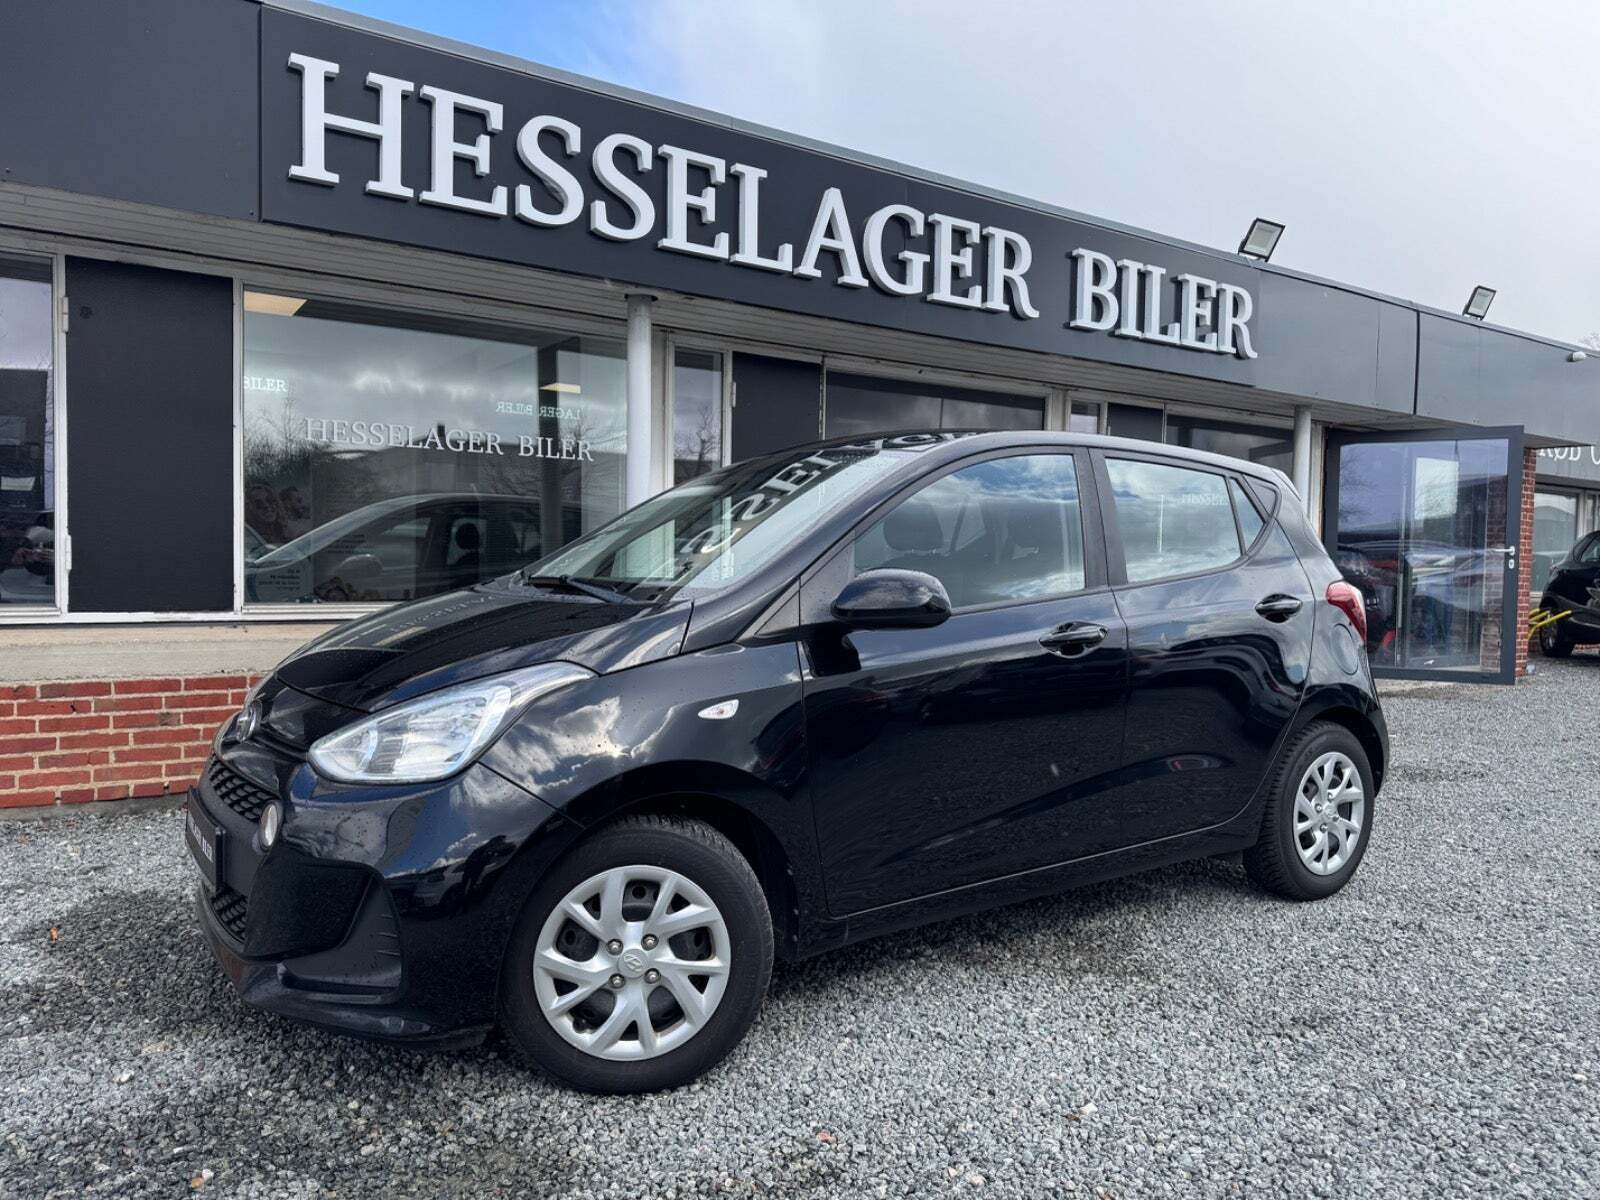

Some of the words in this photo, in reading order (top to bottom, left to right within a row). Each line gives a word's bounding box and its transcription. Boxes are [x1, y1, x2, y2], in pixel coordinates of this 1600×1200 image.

[288, 52, 1040, 318] HESSELAGER
[1069, 247, 1258, 359] BILER
[303, 416, 505, 457] HESSELAGER
[517, 434, 594, 462] BILER
